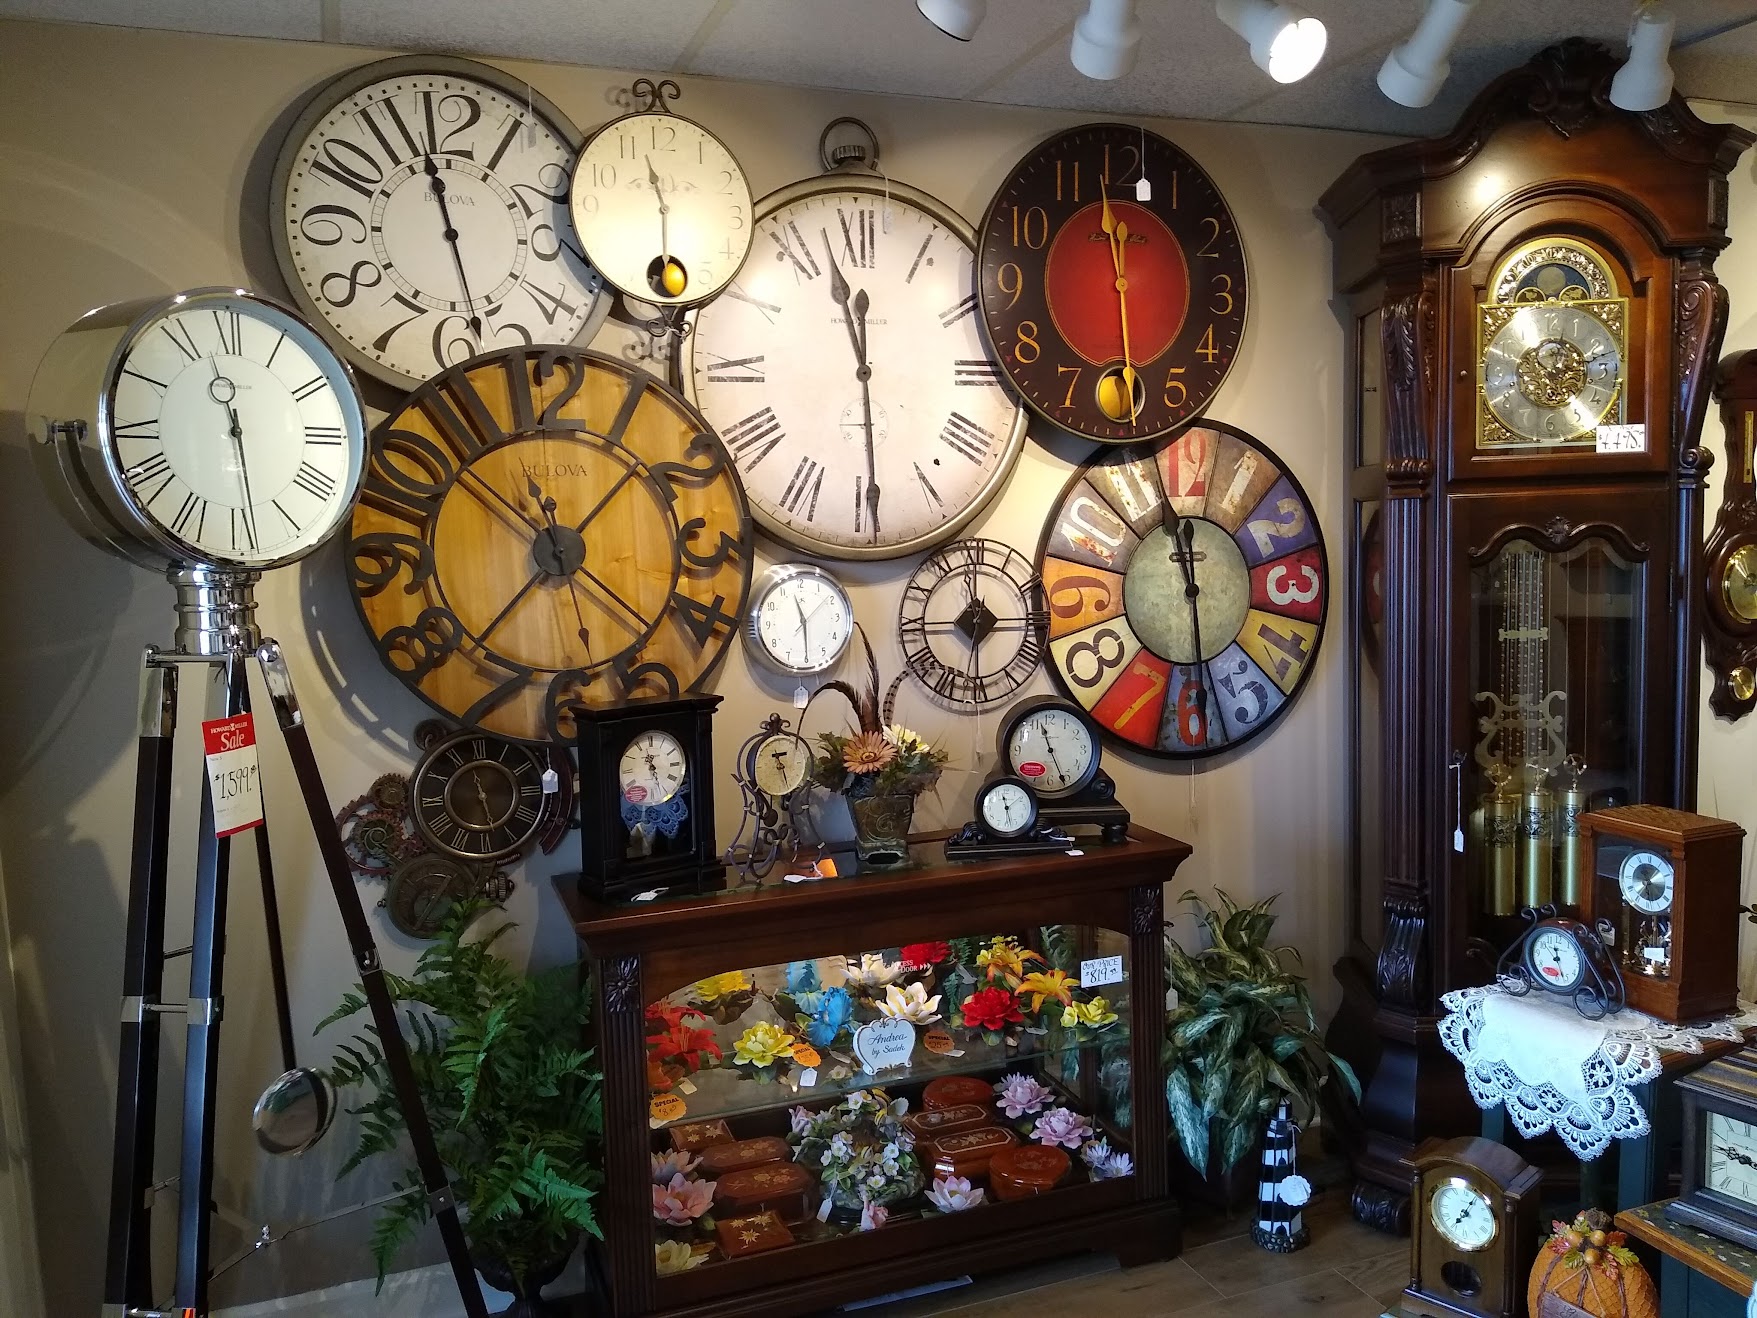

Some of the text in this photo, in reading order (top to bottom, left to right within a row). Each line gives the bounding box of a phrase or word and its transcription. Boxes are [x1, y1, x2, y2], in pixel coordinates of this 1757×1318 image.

[353, 94, 423, 170] 11
[414, 90, 482, 162] 12
[498, 114, 529, 174] 1
[651, 126, 676, 152] 12
[620, 134, 635, 159] 11
[1104, 144, 1140, 188] 12
[308, 138, 384, 203] 10
[593, 163, 616, 189] 10
[719, 170, 733, 195] 2
[1057, 160, 1079, 202] 11
[509, 162, 571, 220] 2
[582, 194, 599, 213] 9
[300, 204, 367, 246] 9
[729, 205, 743, 230] 3
[1012, 205, 1048, 250] 10
[769, 220, 822, 286] XI
[837, 208, 875, 268] XII
[1196, 217, 1220, 258] 2
[905, 233, 933, 283] I
[320, 260, 382, 308] 8
[519, 274, 578, 326] 4
[724, 280, 782, 325] X
[997, 262, 1023, 311] 9
[1208, 274, 1233, 315] 3
[372, 292, 429, 354] 7
[938, 292, 978, 328] II
[1544, 312, 1561, 332] 12
[1573, 319, 1579, 337] 1
[160, 317, 202, 367] XI
[213, 310, 242, 356] XII
[266, 333, 286, 368] I
[1014, 320, 1040, 364] 8
[1195, 324, 1220, 363] 4
[124, 360, 168, 398] X
[707, 352, 765, 382] IX
[954, 359, 1000, 386] III
[1058, 363, 1082, 408] 7
[1599, 363, 1607, 379] 3
[292, 375, 328, 402] II
[504, 350, 586, 431] 12
[1164, 366, 1187, 408] 5
[1502, 391, 1511, 409] 8
[1590, 389, 1601, 404] 4
[114, 416, 160, 440] IX
[417, 365, 505, 467] 11
[604, 372, 650, 448] 1
[1519, 408, 1530, 424] 7
[1545, 413, 1555, 431] 6
[305, 426, 342, 446] III
[721, 406, 786, 474] VIII
[938, 411, 996, 467] IIII
[125, 452, 176, 506] VIII
[293, 460, 336, 502] IIII
[360, 429, 456, 520] 10
[522, 464, 587, 477] BULOVA
[645, 433, 726, 502] 2
[1166, 430, 1207, 498] 12
[1221, 450, 1258, 515] 1
[779, 455, 825, 523] VII
[914, 461, 943, 514] V
[1103, 449, 1163, 522] 11
[170, 491, 207, 542] VII
[231, 508, 256, 550] VI
[272, 499, 301, 538] V
[1060, 496, 1126, 567] 10
[1246, 497, 1306, 558] 2
[676, 516, 747, 568] 3
[348, 532, 434, 595] 9
[780, 587, 785, 596] 11
[797, 579, 804, 588] 12
[830, 596, 834, 605] 2
[1050, 575, 1112, 619] 9
[1266, 565, 1320, 605] 3
[670, 589, 738, 648] 4
[766, 621, 770, 629] 9
[768, 602, 775, 611] 10
[835, 613, 840, 622] 3
[379, 606, 464, 680] 8
[772, 639, 777, 647] 8
[821, 647, 826, 656] 5
[832, 632, 837, 640] 4
[1257, 623, 1311, 682] 4
[786, 652, 790, 661] 7
[1065, 628, 1125, 688] 8
[461, 651, 534, 728] 7
[1114, 661, 1166, 730] 7
[1178, 664, 1208, 747] 6
[1217, 660, 1269, 725] 5
[211, 726, 230, 734] HOWARD
[1045, 714, 1055, 726] 12
[1073, 729, 1079, 740] 2
[221, 730, 244, 751] Sale
[446, 748, 464, 768] XI
[472, 740, 486, 759] XII
[499, 744, 509, 761] I
[1014, 745, 1021, 756] 9
[1080, 745, 1087, 755] 3
[428, 771, 448, 783] X
[513, 761, 532, 776] II
[1047, 775, 1053, 786] 6
[422, 795, 443, 807] IX
[521, 785, 541, 797] III
[428, 812, 453, 837] VIII
[504, 825, 518, 842] V
[515, 805, 537, 824] IIII
[451, 828, 469, 850] VII
[480, 833, 492, 852] VI
[1098, 958, 1119, 969] PRICE
[868, 1033, 907, 1045] Andrea
[872, 1048, 880, 1059] by
[654, 1098, 679, 1107] SPECIAL
